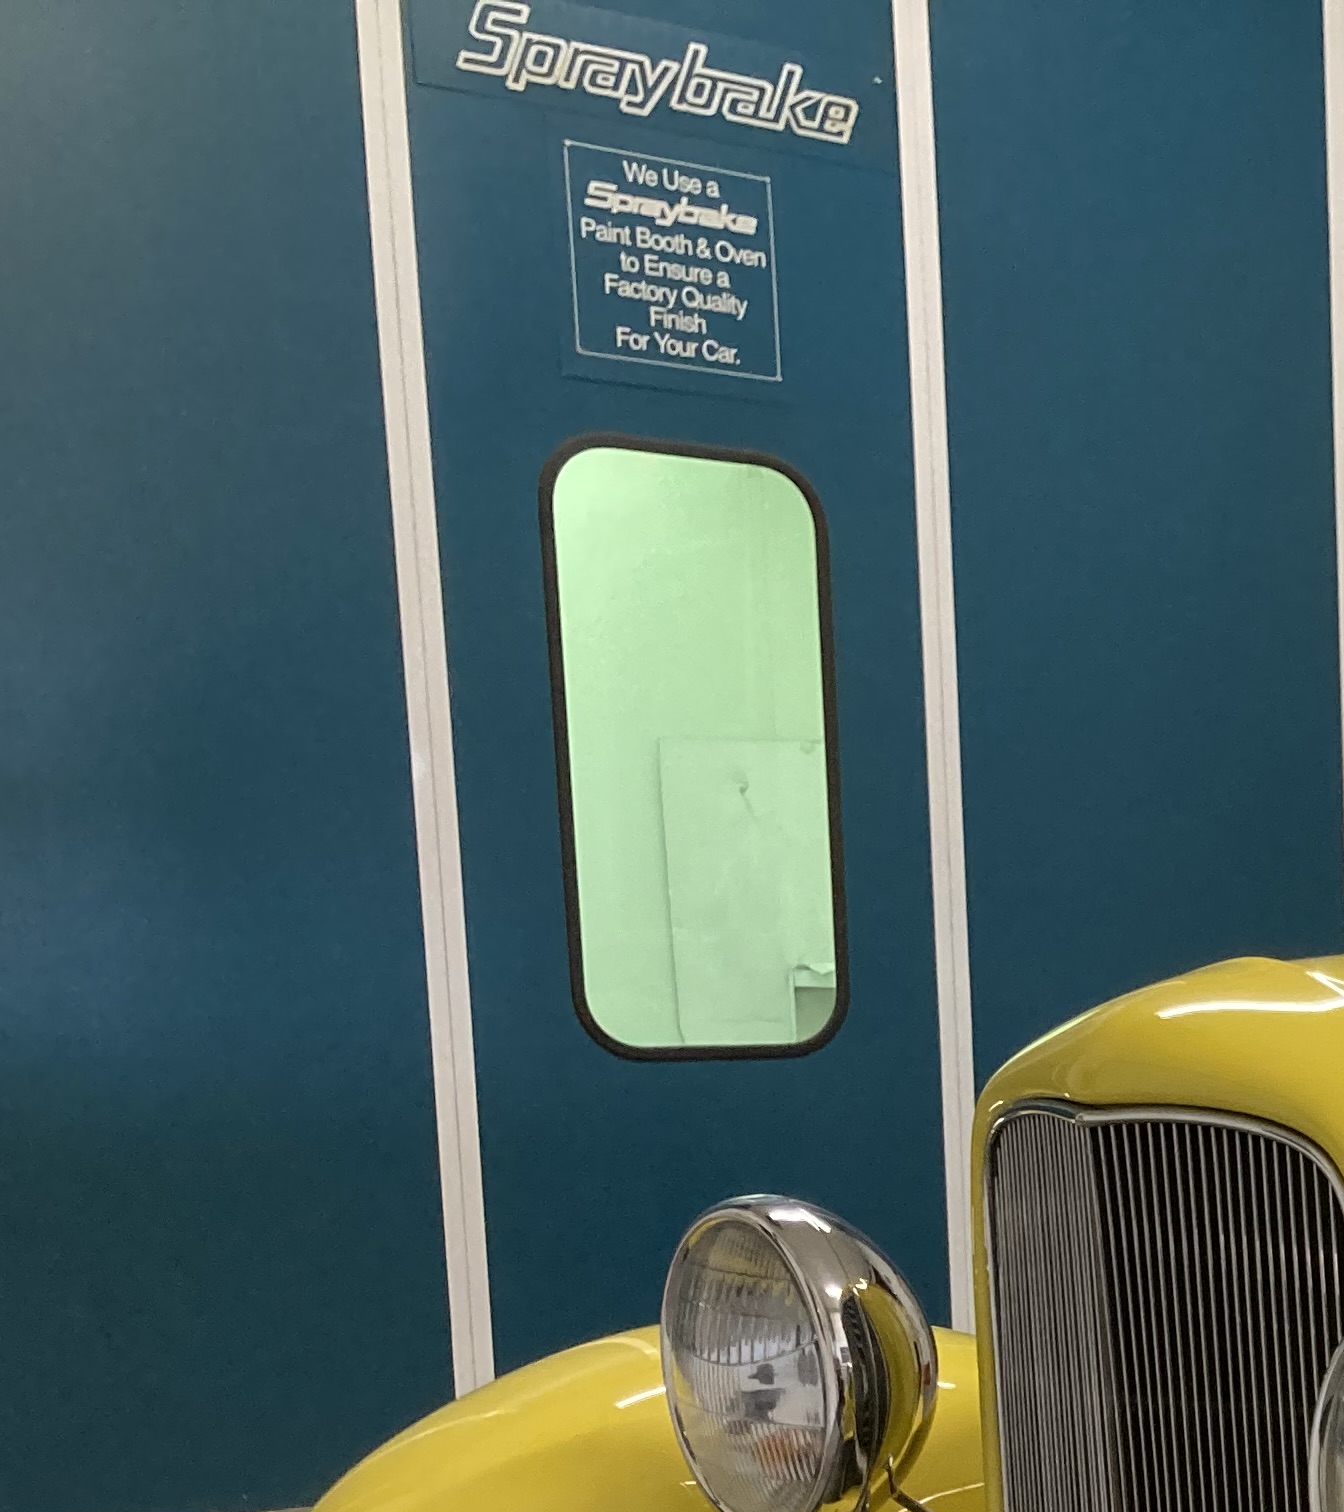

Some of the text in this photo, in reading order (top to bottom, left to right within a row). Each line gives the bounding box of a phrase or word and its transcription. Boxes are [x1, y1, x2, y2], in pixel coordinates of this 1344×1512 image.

[455, 0, 860, 145] Spraybake
[622, 160, 721, 198] We Use a
[583, 179, 759, 236] Spraybake
[580, 217, 767, 269] Paint Booth & Oven
[620, 252, 731, 289] to Ensure a
[603, 273, 749, 321] Factory Quality
[649, 306, 708, 335] Finish
[615, 326, 741, 365] For Your Car.
